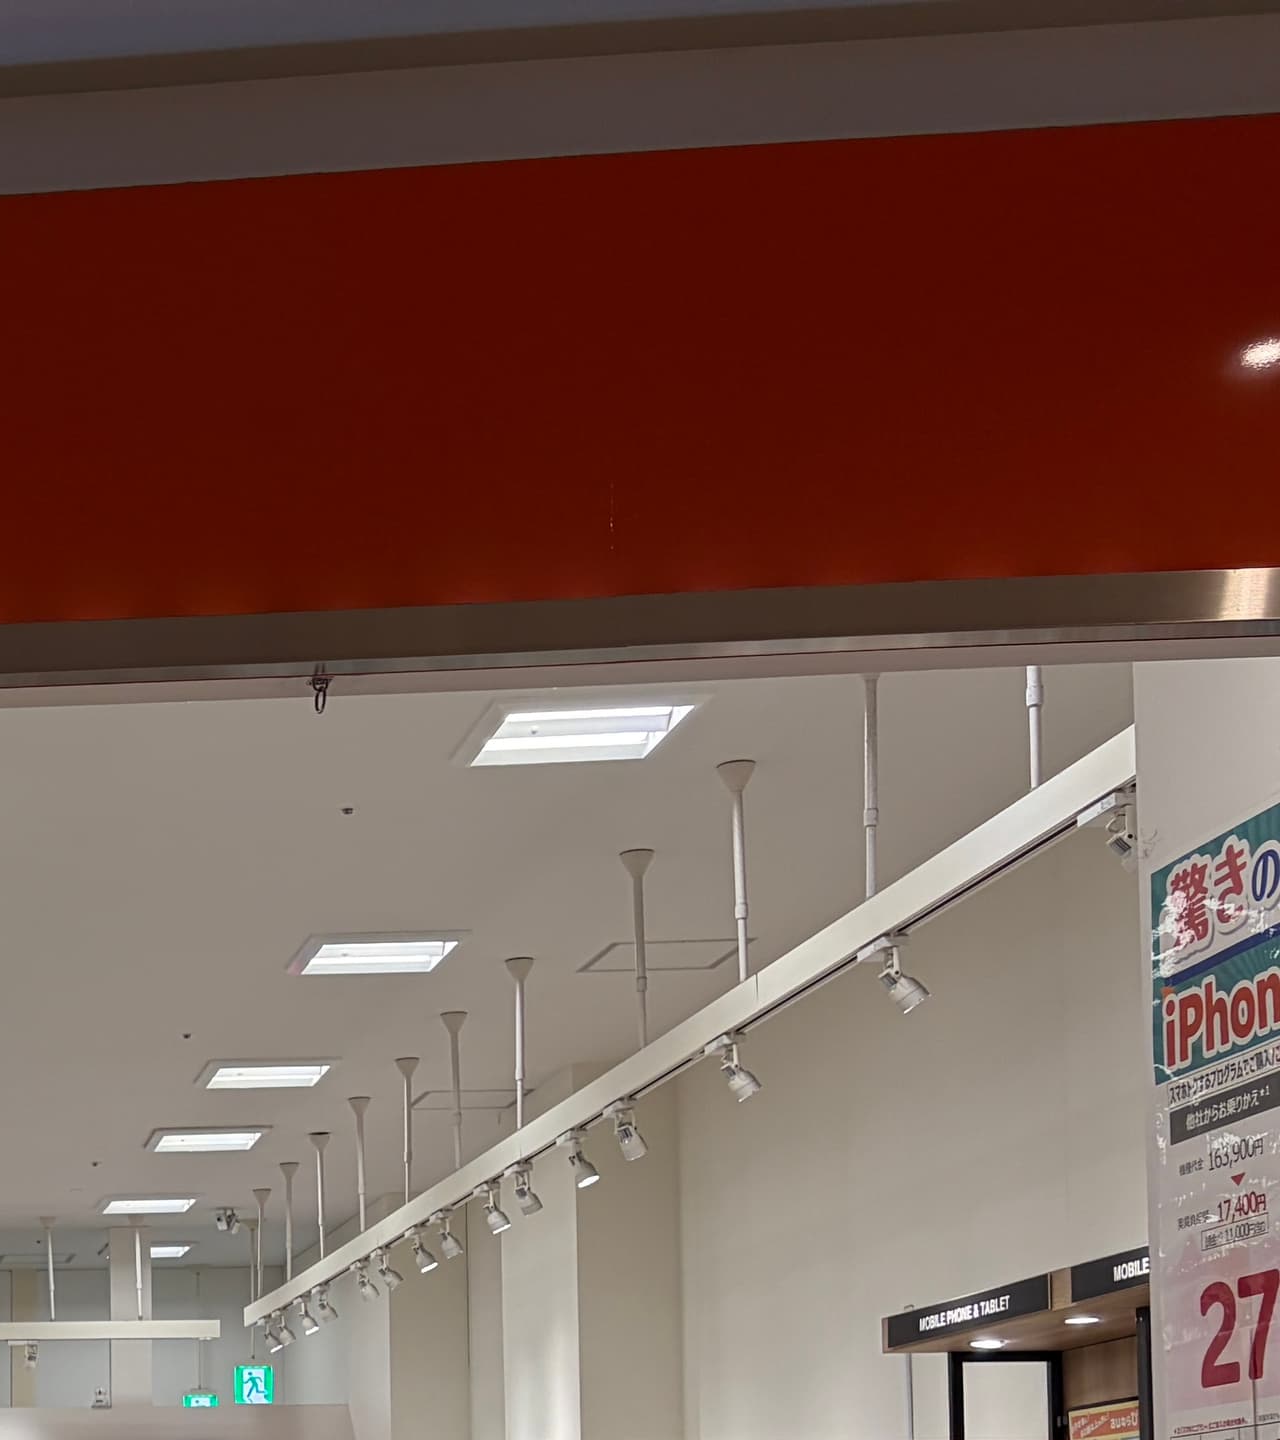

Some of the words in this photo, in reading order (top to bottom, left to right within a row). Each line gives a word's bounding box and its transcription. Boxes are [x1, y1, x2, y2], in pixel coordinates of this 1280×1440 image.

[1166, 972, 1280, 1068] iPhon
[919, 1310, 946, 1332] MOBILE
[946, 1305, 973, 1325] PHONE
[980, 1295, 1010, 1315] TABLET
